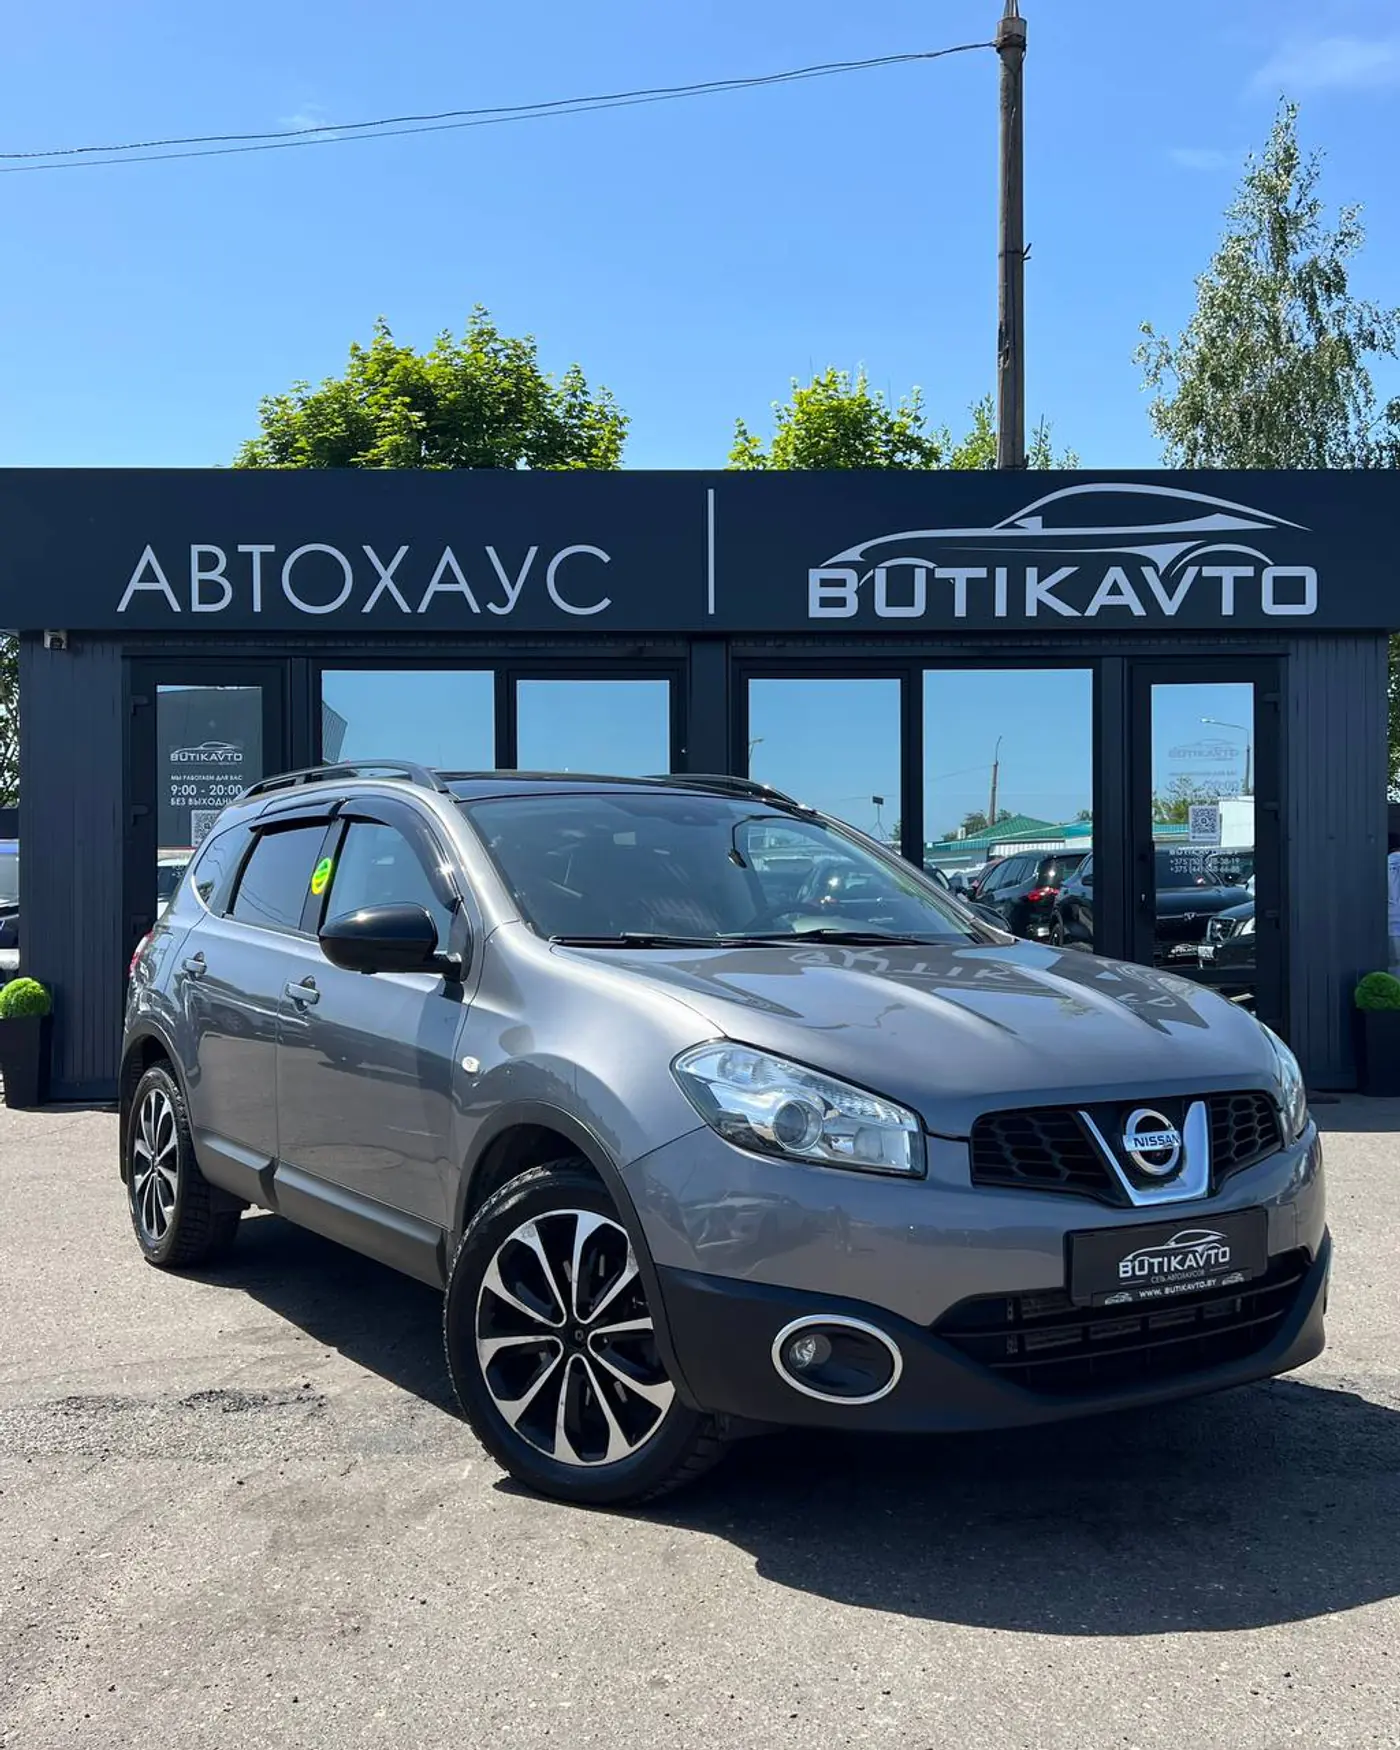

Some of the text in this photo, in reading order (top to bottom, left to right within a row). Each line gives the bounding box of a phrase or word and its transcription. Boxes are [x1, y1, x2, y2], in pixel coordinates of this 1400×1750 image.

[116, 543, 612, 615] АВТОХАУС
[808, 565, 1318, 618] BUTIKAVTO
[170, 753, 243, 762] BUTIKAVTO
[170, 784, 197, 796] 9:00
[209, 784, 243, 796] 20:00
[170, 797, 233, 807] БЕЗ ВЫХОДН
[1133, 1133, 1180, 1148] NISSAN
[1118, 1246, 1231, 1279] BUTIKAVTO
